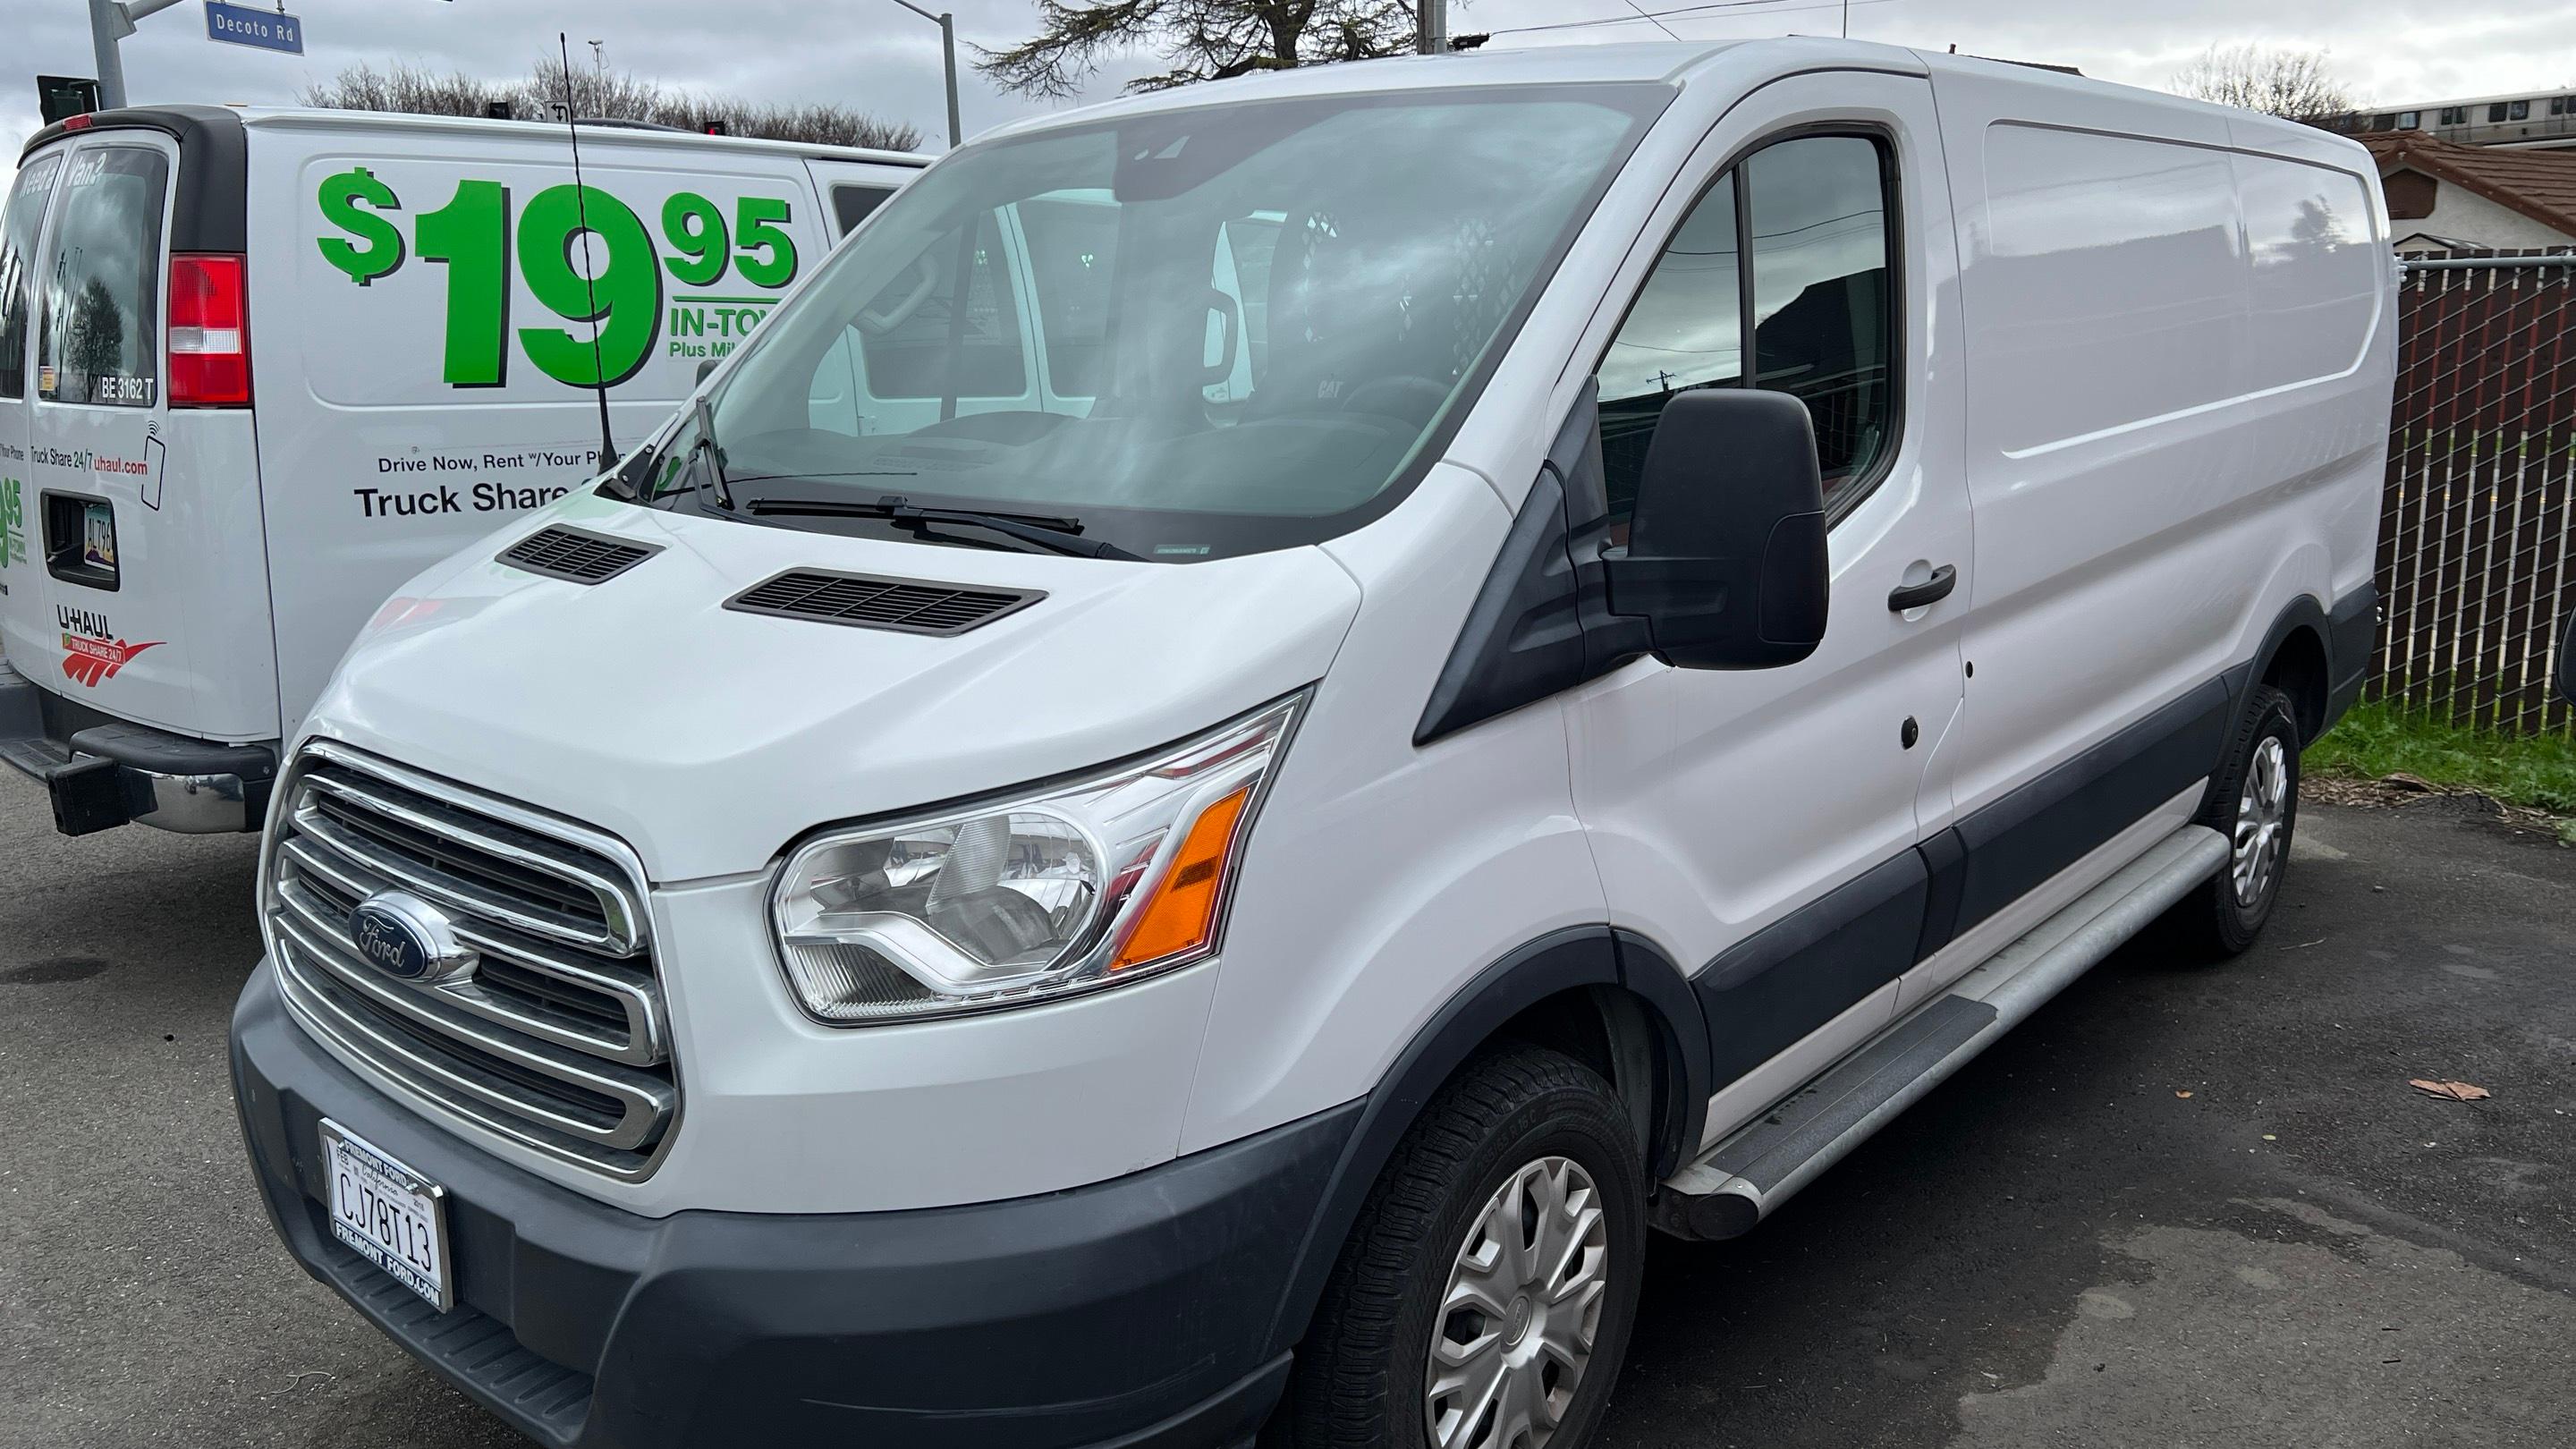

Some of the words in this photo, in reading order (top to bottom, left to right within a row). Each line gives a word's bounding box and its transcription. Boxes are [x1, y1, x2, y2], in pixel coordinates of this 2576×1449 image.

[216, 13, 267, 38] Decoto
[276, 24, 293, 42] Rd
[67, 152, 106, 187] Van?
[669, 308, 767, 337] IN-TO
[669, 342, 706, 357] Plus
[711, 342, 736, 357] Mil
[102, 377, 116, 399] BE
[118, 377, 143, 400] 3162
[145, 377, 154, 400] T
[1318, 380, 1344, 399] CAT
[30, 445, 48, 464] Truck
[50, 447, 72, 468] Share
[73, 448, 93, 472] 24/7
[94, 455, 148, 475] uhaul.com
[378, 457, 427, 473] Drive
[433, 455, 479, 472] Now,
[484, 453, 524, 469] Rent
[354, 485, 462, 517] Truck
[56, 604, 114, 640] U-HAUL
[72, 639, 89, 653] TRUCK
[89, 643, 107, 658] SHARE
[108, 648, 123, 662] 24/7
[359, 914, 406, 967] Ford
[343, 1138, 384, 1174] FREMONT
[384, 1162, 407, 1187] FORD
[340, 1173, 431, 1272] CJ78T13
[335, 1222, 384, 1265] FREMONT
[386, 1255, 440, 1306] FORD.COM
